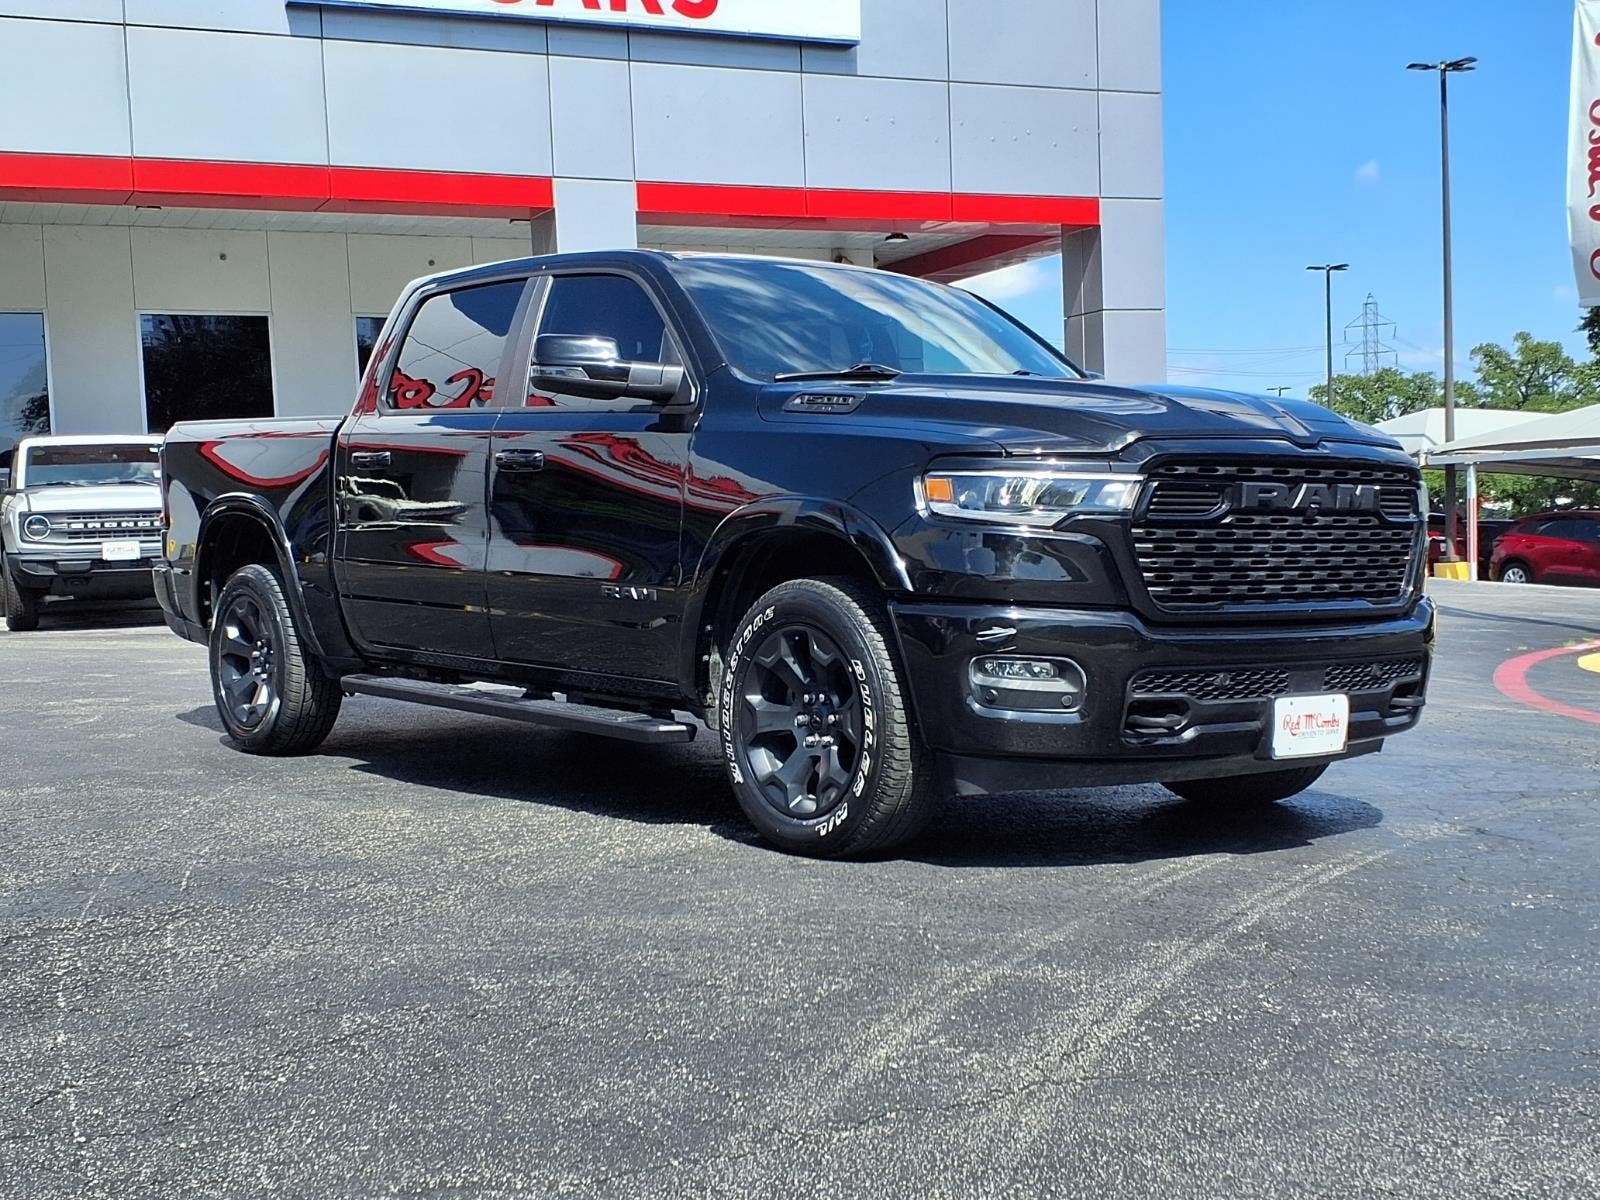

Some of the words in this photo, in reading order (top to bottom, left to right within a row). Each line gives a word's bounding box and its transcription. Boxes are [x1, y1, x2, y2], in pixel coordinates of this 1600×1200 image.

[1236, 482, 1380, 509] RAM
[600, 585, 657, 601] RAM
[851, 659, 878, 797] DUELER
[1283, 714, 1301, 736] Red
